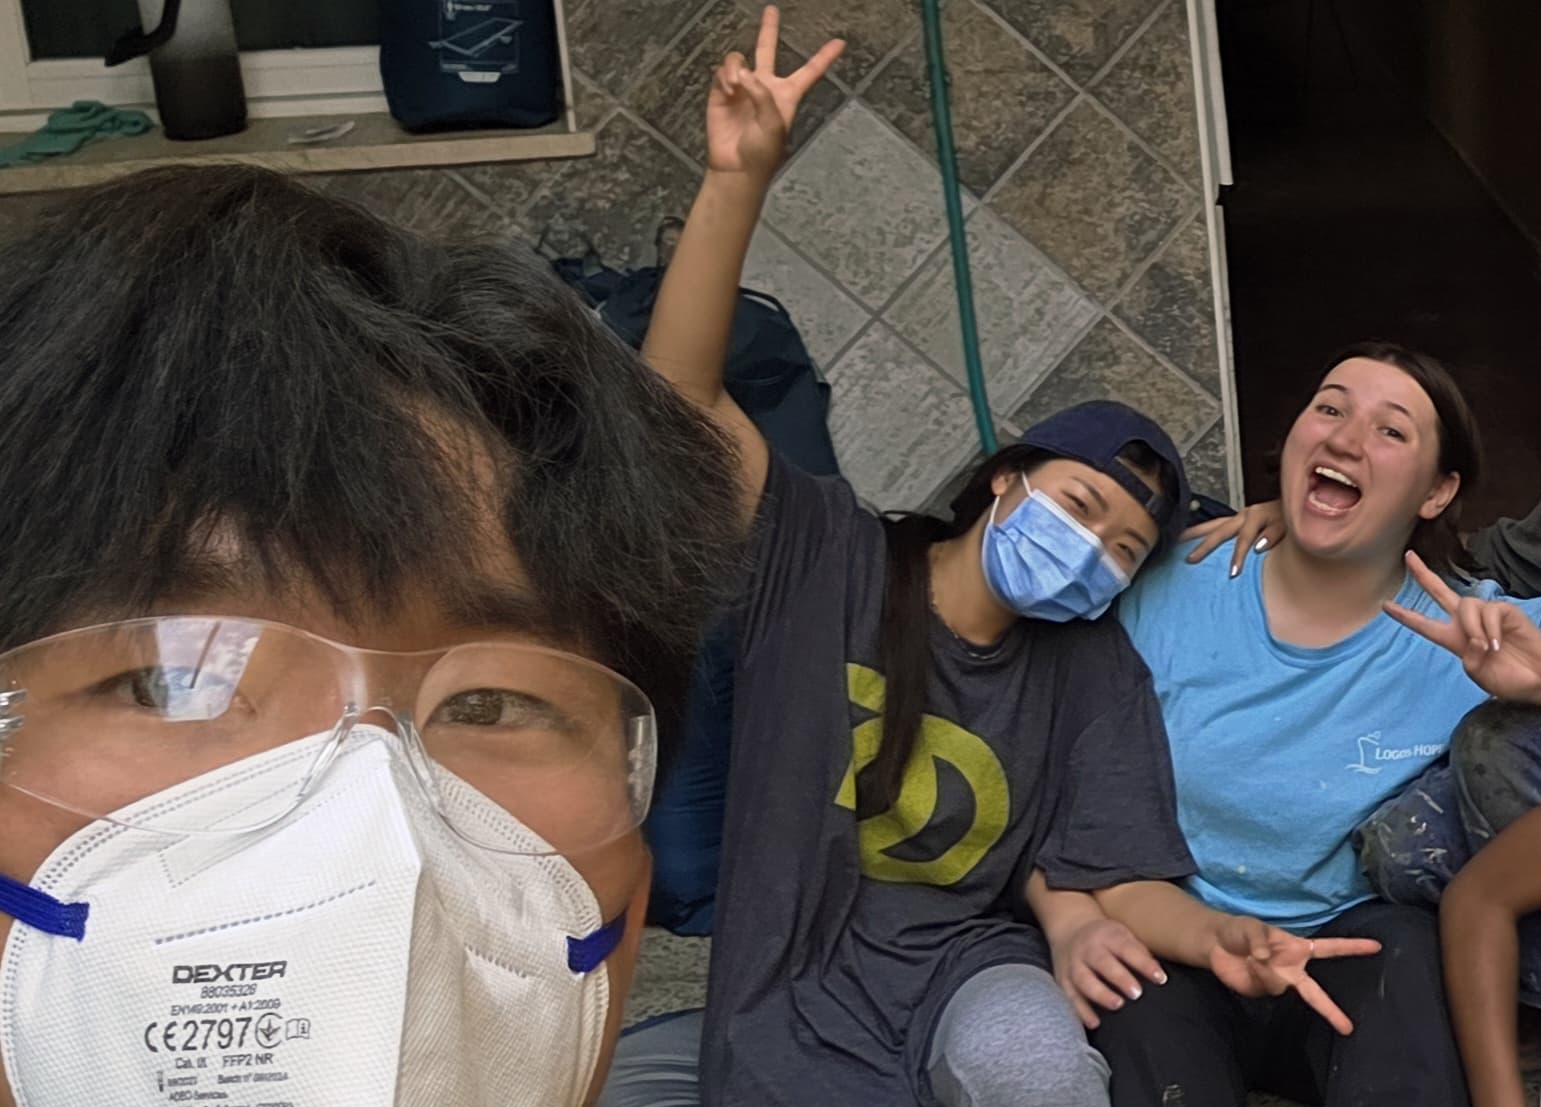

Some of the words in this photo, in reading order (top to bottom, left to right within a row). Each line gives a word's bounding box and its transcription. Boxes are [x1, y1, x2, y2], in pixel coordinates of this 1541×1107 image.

[172, 960, 288, 984] DEXTER
[182, 1017, 252, 1051] 2797
[255, 1053, 274, 1065] NR
